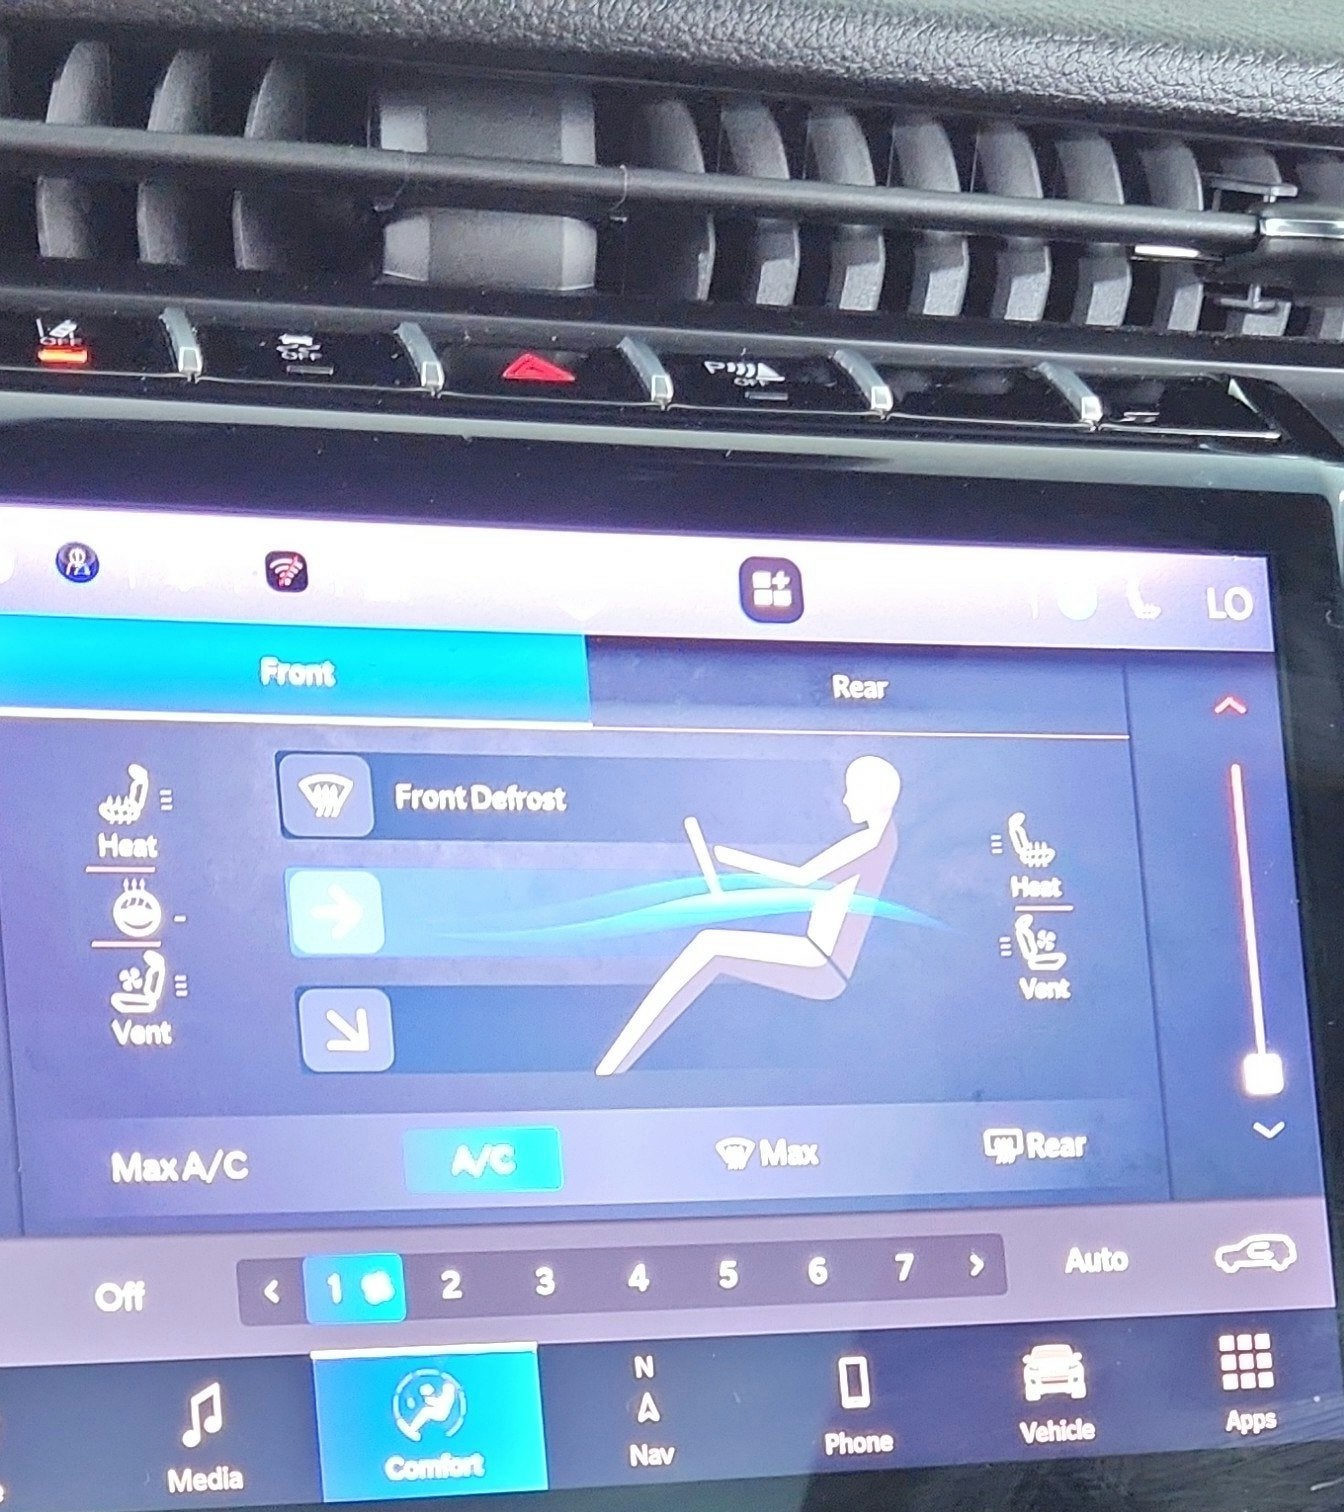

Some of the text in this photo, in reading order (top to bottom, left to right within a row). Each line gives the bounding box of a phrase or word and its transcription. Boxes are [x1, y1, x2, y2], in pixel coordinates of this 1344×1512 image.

[1206, 587, 1254, 621] LO
[259, 657, 336, 686] Front
[831, 674, 889, 700] Rear
[395, 782, 566, 812] Front Defrost
[97, 833, 158, 859] Heat
[1011, 875, 1062, 900] Heat
[1020, 976, 1070, 1001] Vent
[111, 1020, 172, 1045] Vent
[451, 1142, 516, 1177] A/C
[760, 1138, 819, 1167] Max
[1026, 1132, 1087, 1160] Rear
[111, 1150, 249, 1184] Max A/C
[1064, 1246, 1129, 1275] Auto
[326, 1252, 916, 1304] 1 2 3 4 5 6 7
[93, 1280, 146, 1313] Off
[634, 1355, 655, 1379] N
[1019, 1418, 1096, 1446] Vehicle
[1225, 1408, 1278, 1434] Apps
[629, 1443, 675, 1468] Nav
[824, 1430, 894, 1456] Phone
[168, 1465, 244, 1494] Media
[384, 1452, 485, 1481] Comfort
